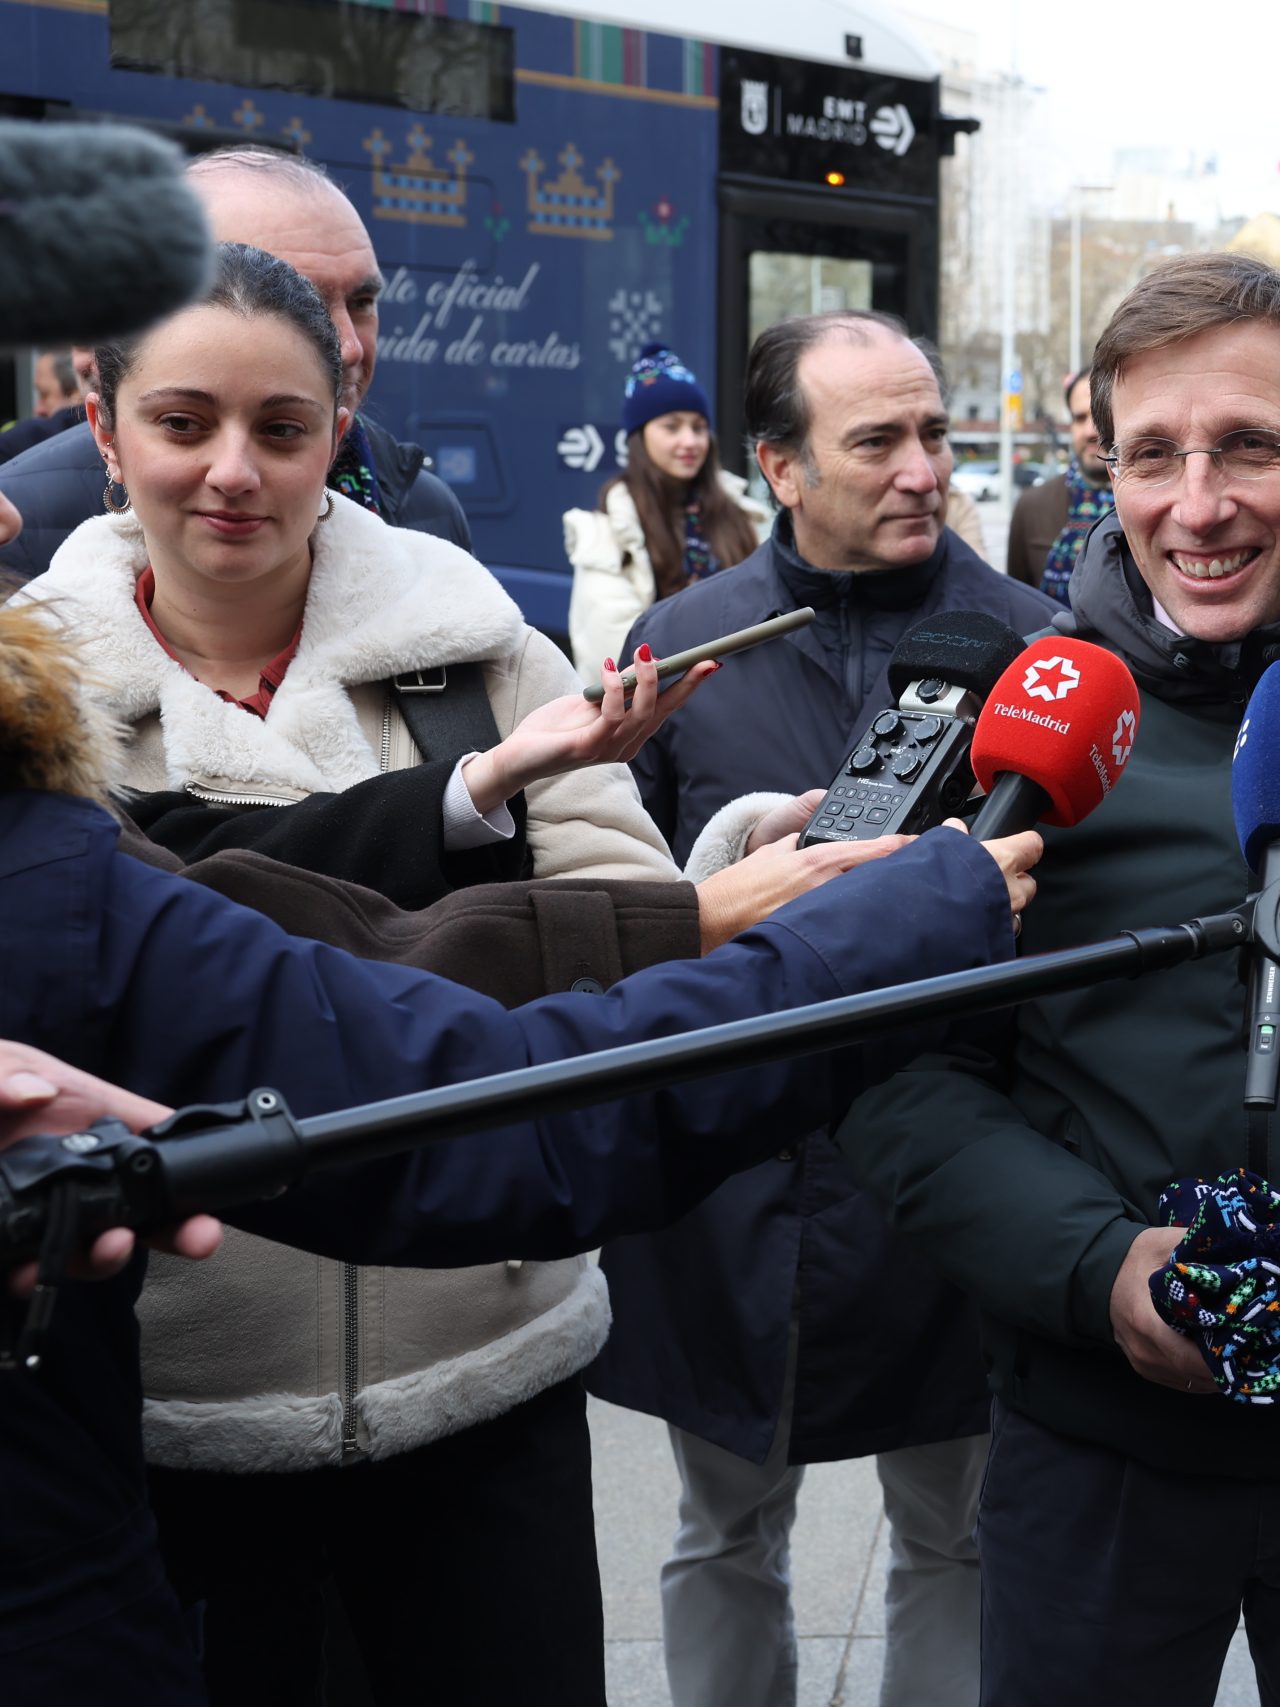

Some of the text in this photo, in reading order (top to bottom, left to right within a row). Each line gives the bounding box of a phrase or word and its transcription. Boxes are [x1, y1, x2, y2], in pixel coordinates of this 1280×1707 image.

[823, 95, 867, 122] EMT
[786, 113, 867, 146] MADRID
[425, 258, 541, 330] oficial
[444, 314, 485, 365] de
[490, 331, 581, 370] cartas
[994, 703, 1071, 735] TeleMadrid
